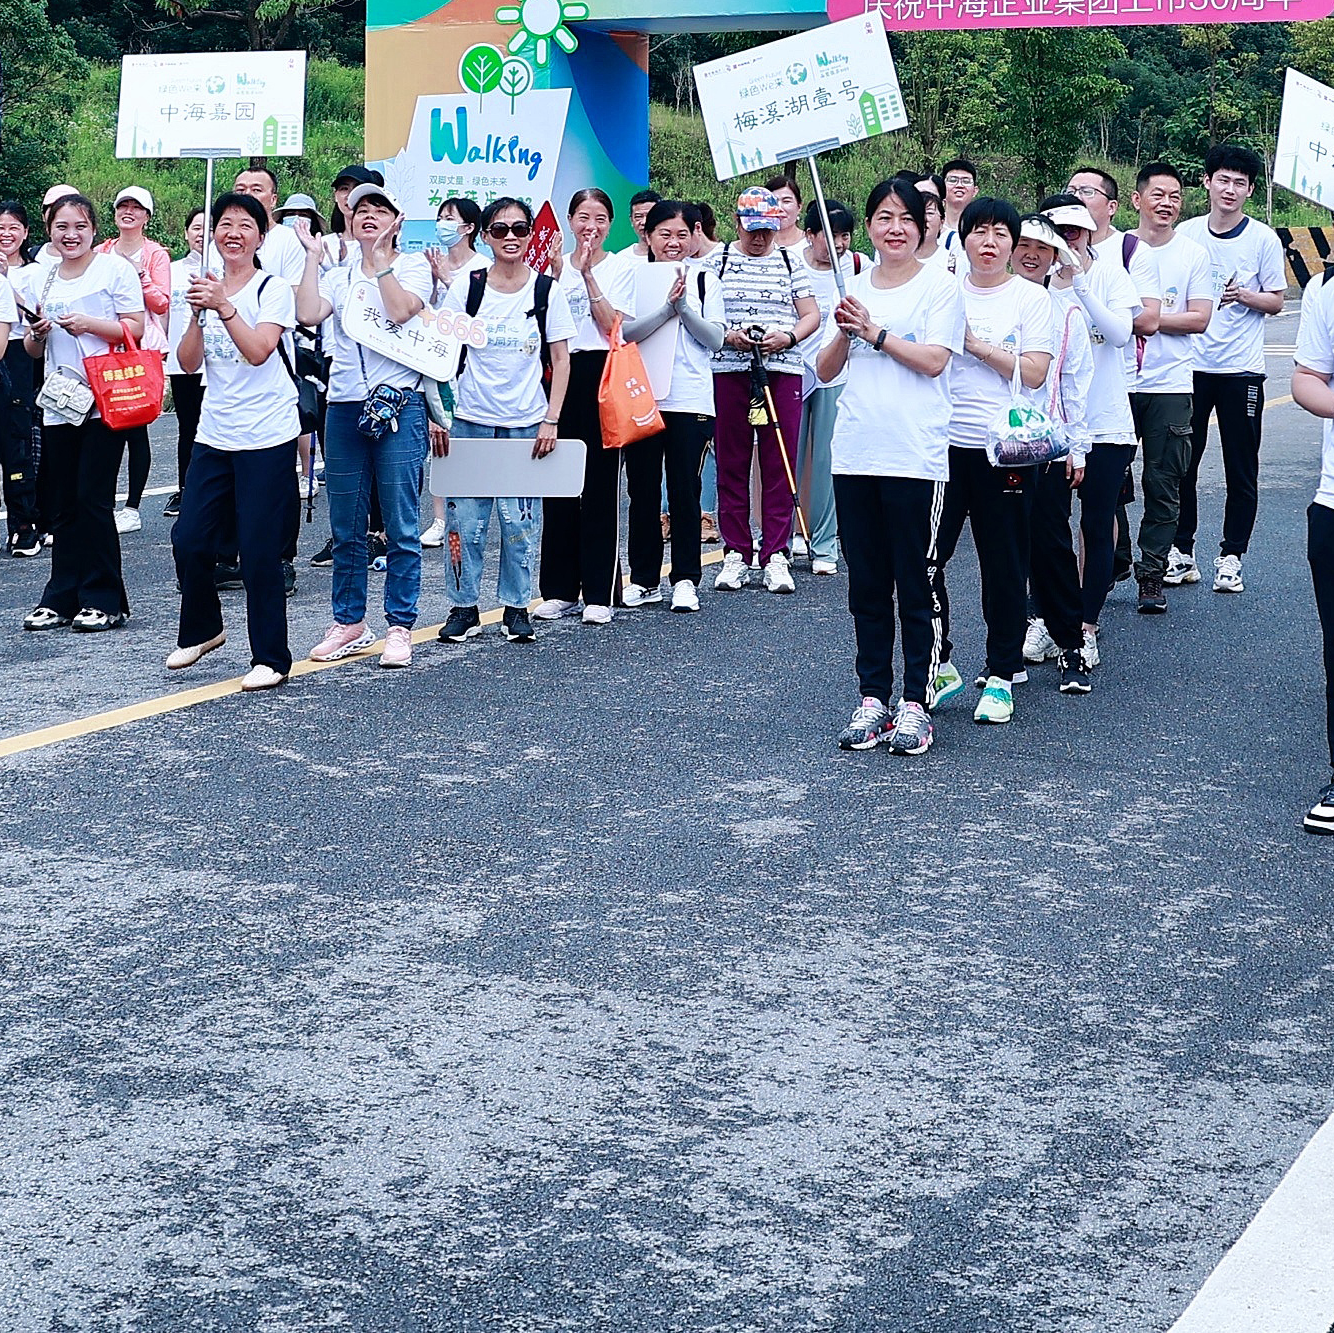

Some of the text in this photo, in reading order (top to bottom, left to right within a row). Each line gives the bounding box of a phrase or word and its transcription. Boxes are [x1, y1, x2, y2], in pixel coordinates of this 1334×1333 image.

[160, 101, 255, 123] 中海嘉园
[733, 79, 860, 133] 梅溪湖壹号
[430, 106, 543, 181] Walking
